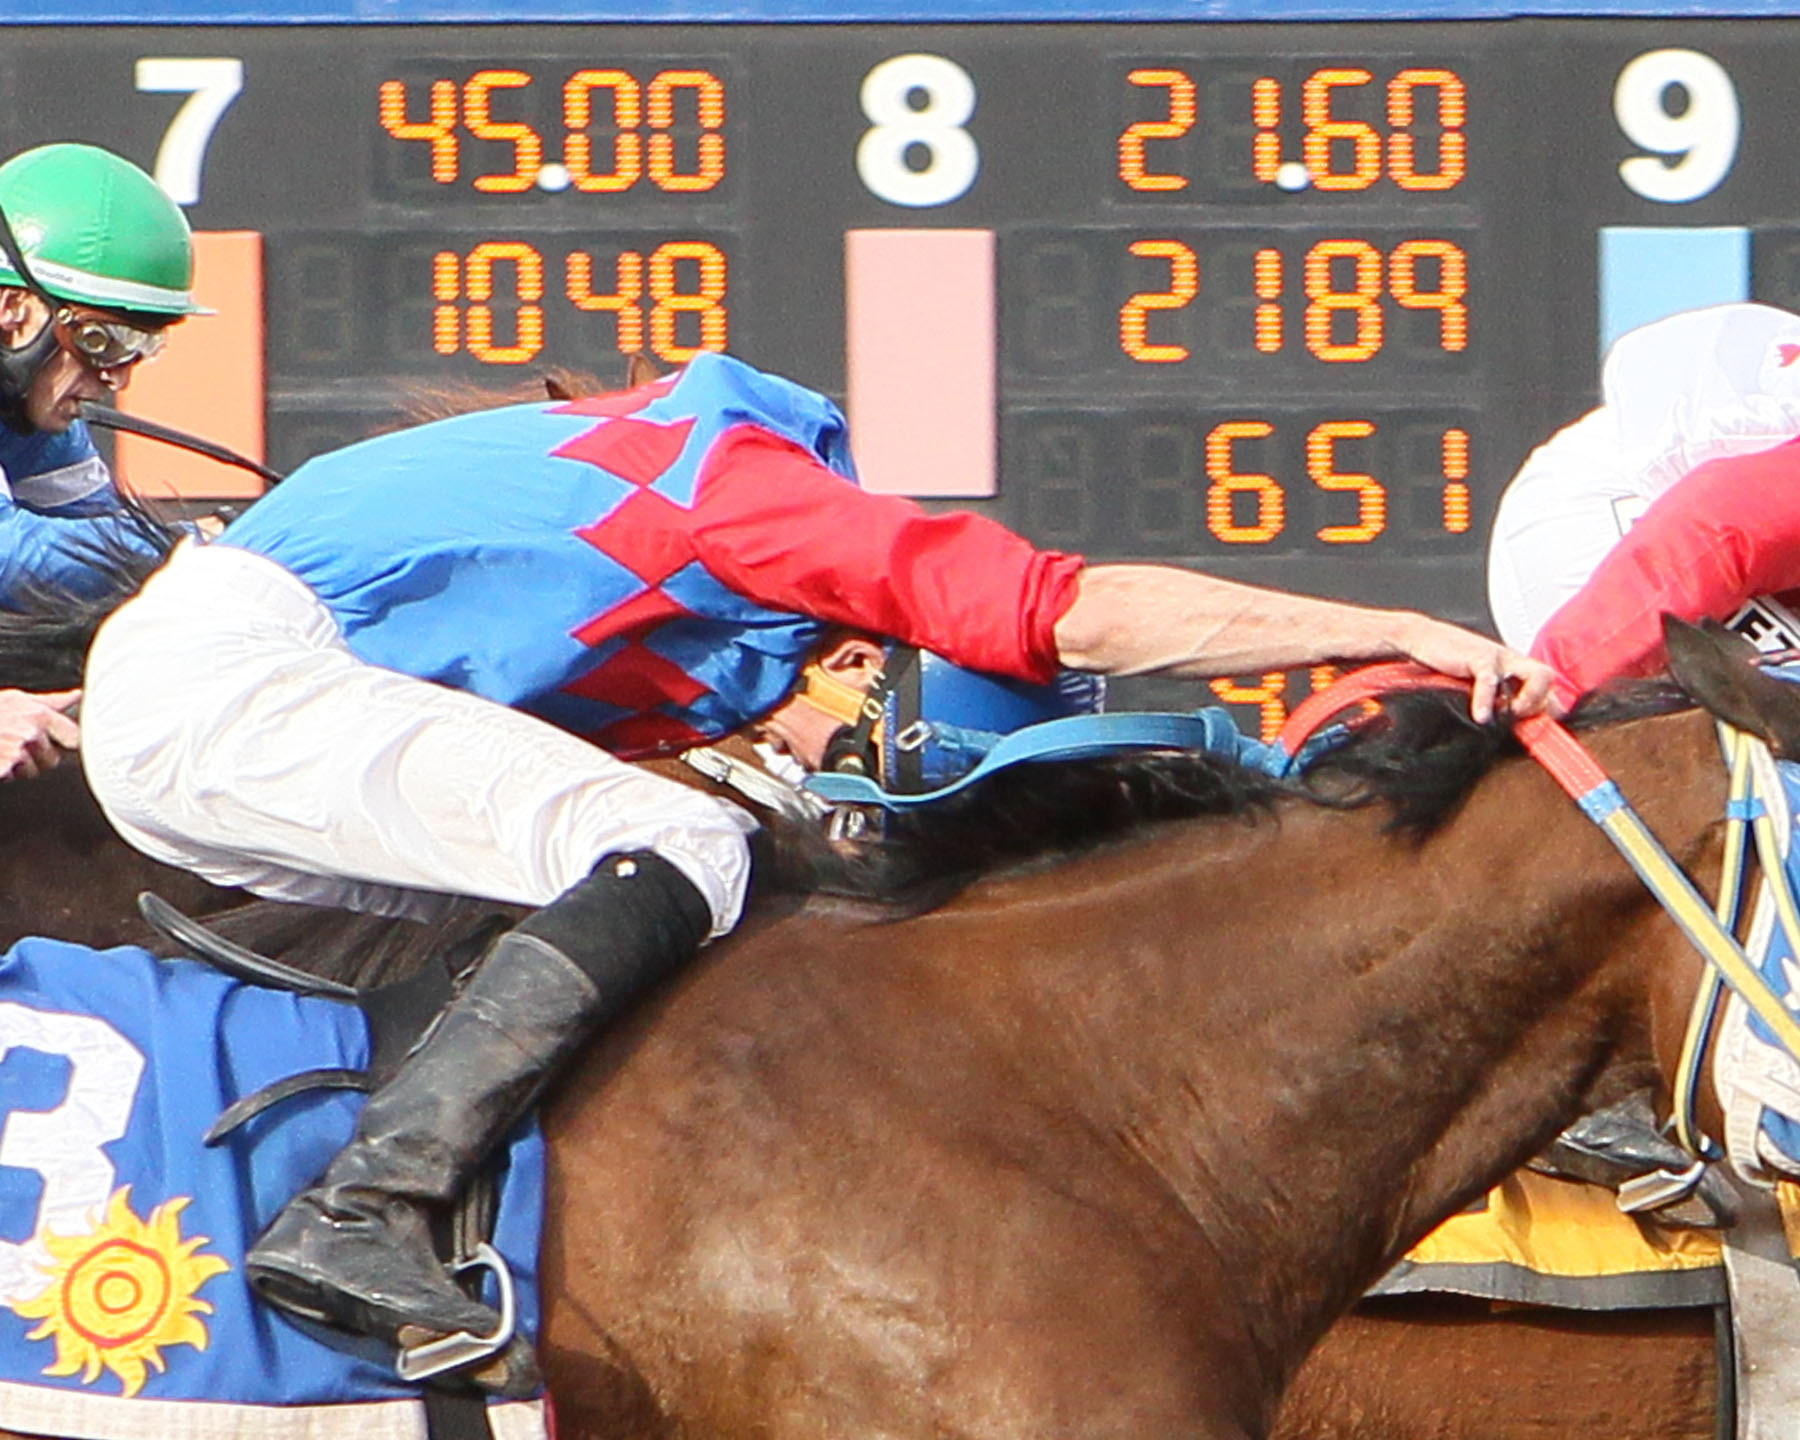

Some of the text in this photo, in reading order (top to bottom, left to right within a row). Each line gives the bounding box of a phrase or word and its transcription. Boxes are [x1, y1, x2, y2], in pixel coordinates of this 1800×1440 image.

[134, 58, 244, 205] 7
[379, 69, 725, 193] 45.00
[856, 55, 979, 206] 8
[1118, 68, 1466, 191] 21.60
[1614, 50, 1740, 202] 9
[433, 241, 728, 365] 1048
[1120, 239, 1467, 363] 2189
[1206, 420, 1470, 543] 651
[0, 1003, 146, 1304] 3
